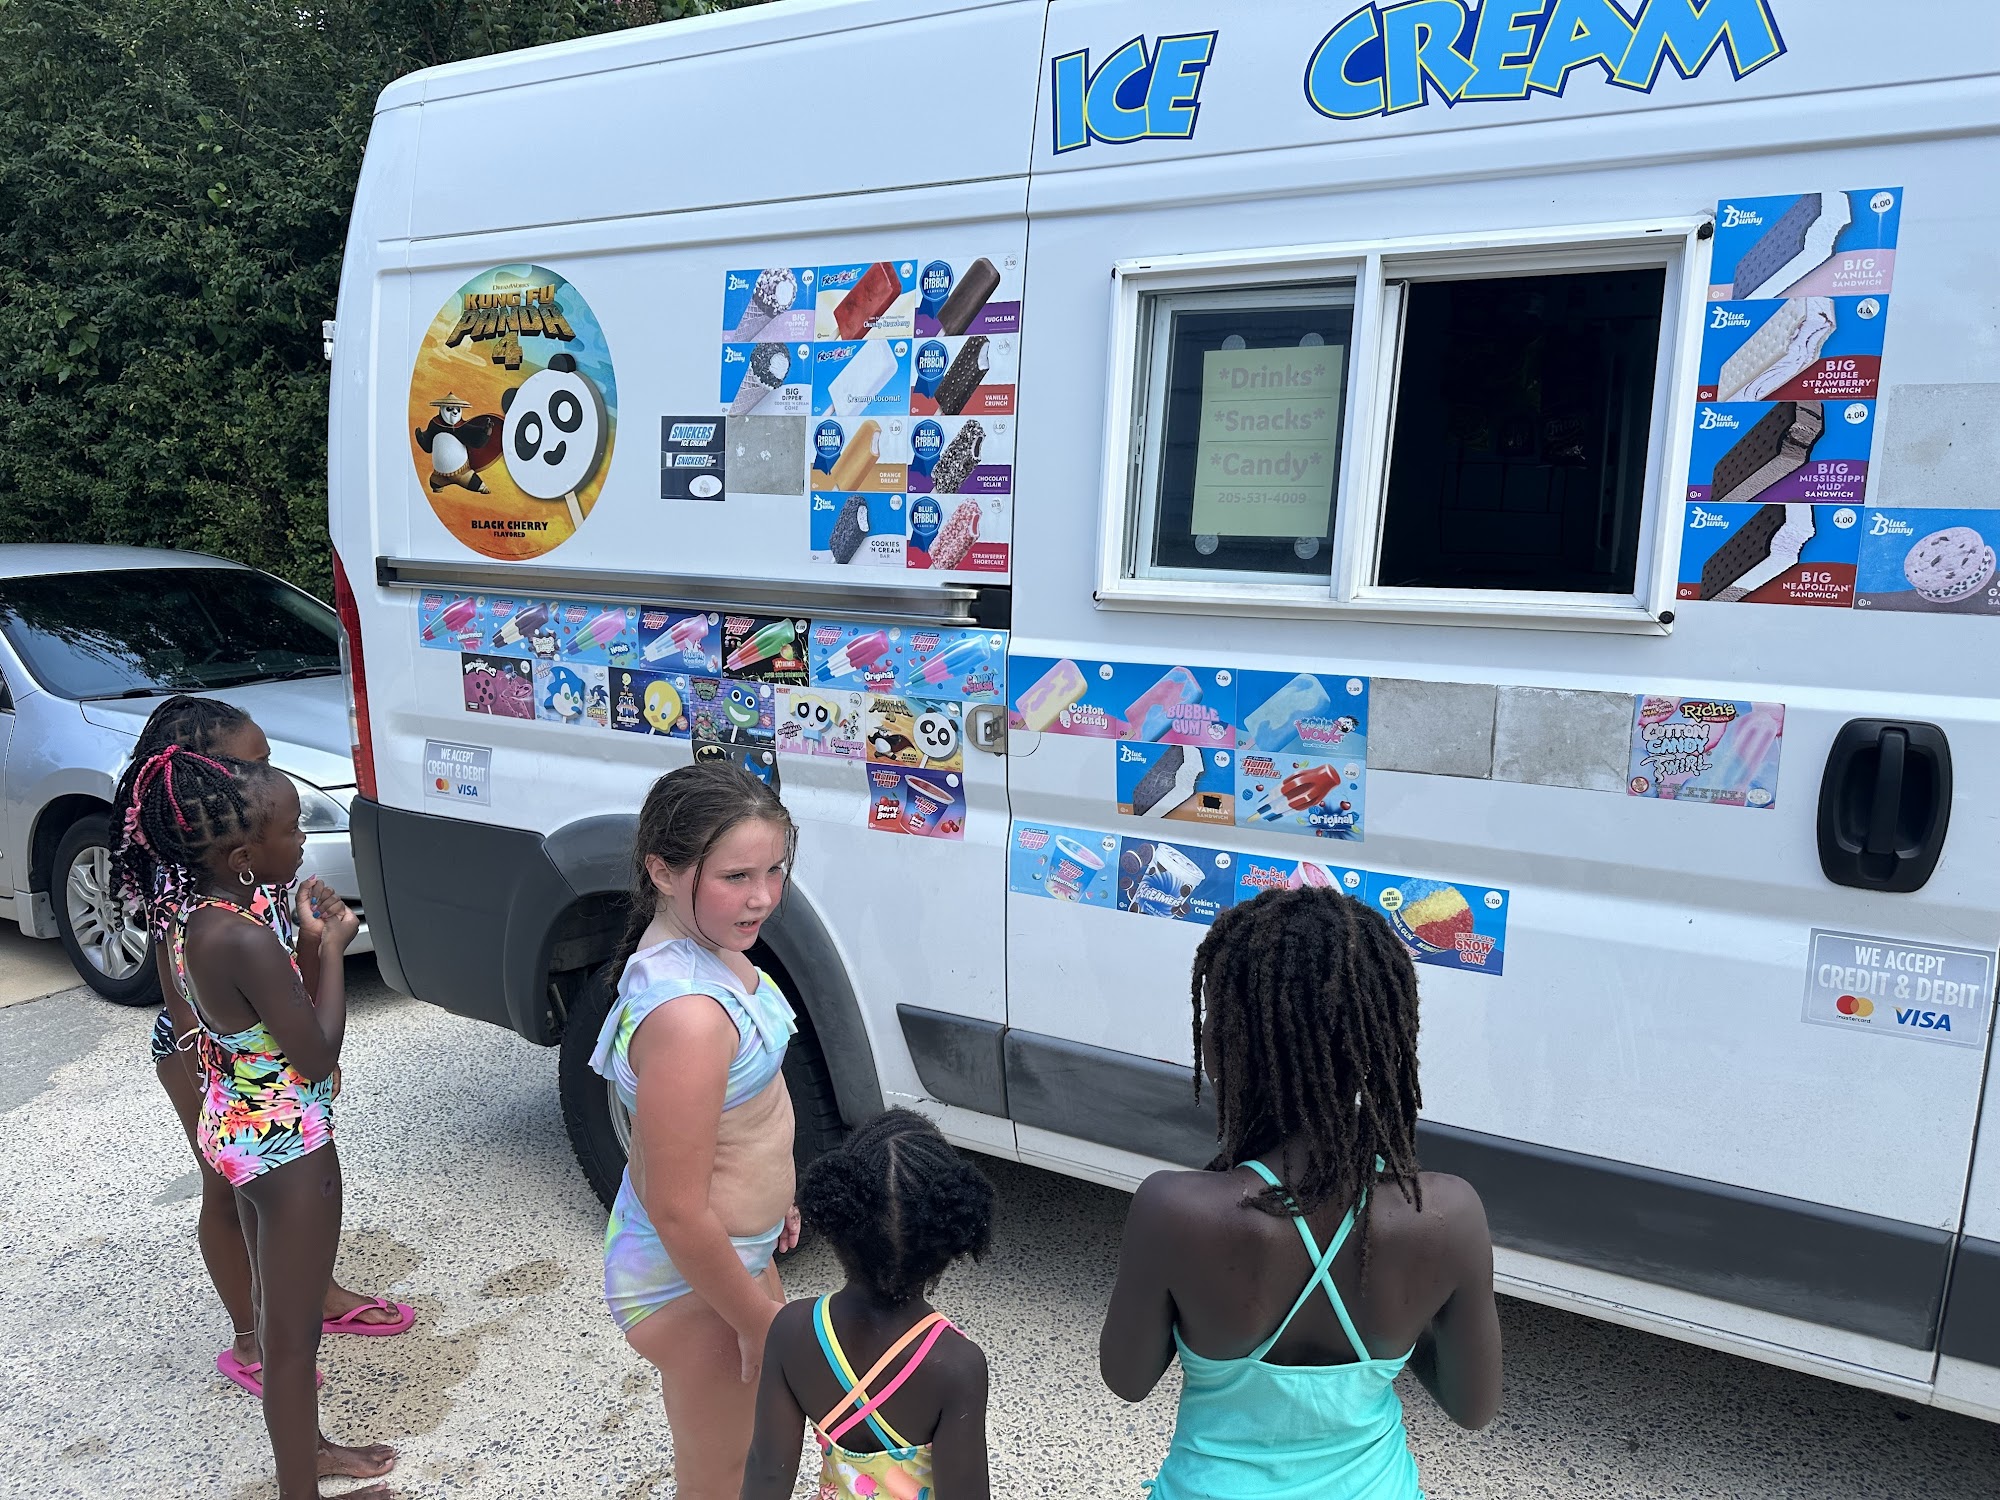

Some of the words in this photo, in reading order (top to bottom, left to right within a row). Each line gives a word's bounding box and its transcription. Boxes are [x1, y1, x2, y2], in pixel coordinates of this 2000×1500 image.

[1052, 30, 1218, 155] ICE
[1304, 0, 1787, 120] CREAM
[1872, 198, 1891, 210] 4.00
[1844, 258, 1875, 270] BIG
[928, 270, 944, 278] BLUE
[1834, 271, 1882, 279] VANILLA
[924, 276, 949, 290] RIBBON
[464, 293, 520, 310] KUNG
[526, 284, 556, 305] FU
[445, 304, 576, 348] PANDA
[492, 331, 523, 370] 4
[919, 356, 944, 369] RIBBON
[1826, 360, 1856, 371] BIG
[1817, 371, 1859, 379] DOUBLE
[1802, 378, 1871, 388] STRAWBERRY
[848, 394, 872, 405] Creamy
[874, 394, 900, 402] Coconut
[1846, 411, 1865, 420] 4.00
[672, 426, 713, 438] SNICKERS
[818, 436, 840, 447] RIBBON
[916, 436, 940, 448] RIBBON
[677, 456, 706, 465] SNICKERS
[1817, 463, 1849, 474] BIG
[1799, 474, 1864, 482] MISSISSIPPI
[1217, 492, 1307, 505] 205-531-4009
[1805, 490, 1854, 498] SANDWICH
[914, 512, 938, 524] RIBBON
[1834, 515, 1853, 524] 4.00
[472, 520, 504, 529] BLACK
[507, 521, 548, 530] CHERRY
[1801, 572, 1832, 583] BIG
[1782, 583, 1849, 592] NEAPOLITAN
[1790, 592, 1838, 600] SANDWICH
[864, 671, 895, 682] Original
[966, 673, 994, 685] CANDY
[587, 708, 608, 716] SONIC
[1068, 702, 1104, 715] Cotton
[1166, 704, 1220, 722] BUBBLE
[1682, 702, 1736, 723] Rich's
[1072, 714, 1108, 730] Candy
[1172, 720, 1202, 736] GUM
[1642, 722, 1710, 741] COTTON
[1646, 738, 1709, 755] CANDY
[440, 748, 452, 760] WE
[452, 750, 474, 764] ACCEPT
[428, 760, 454, 778] CREDIT
[455, 764, 462, 778] &
[463, 765, 486, 782] DEBIT
[1640, 753, 1713, 783] TWIRL
[456, 784, 478, 796] VISA
[878, 804, 898, 813] Berry
[1197, 806, 1228, 814] VANILLA
[877, 812, 897, 820] Burst
[1309, 813, 1354, 828] Original
[1249, 864, 1286, 880] Two-Ball
[1050, 874, 1080, 892] Watermelon
[1240, 874, 1290, 890] Screwball
[1190, 898, 1214, 907] Cookies
[1194, 906, 1214, 916] Cream
[1401, 928, 1415, 940] GUM
[1454, 932, 1479, 940] BUBBLE
[1454, 940, 1493, 954] SNOW
[1460, 952, 1486, 966] CONE
[1855, 946, 1881, 968] WE
[1884, 950, 1945, 976] ACCEPT
[1818, 964, 1890, 996] CREDIT
[1894, 974, 1910, 999] &
[1916, 978, 1980, 1009] DEBIT
[1836, 1014, 1872, 1024] mastercard
[1893, 1006, 1952, 1032] VISA
